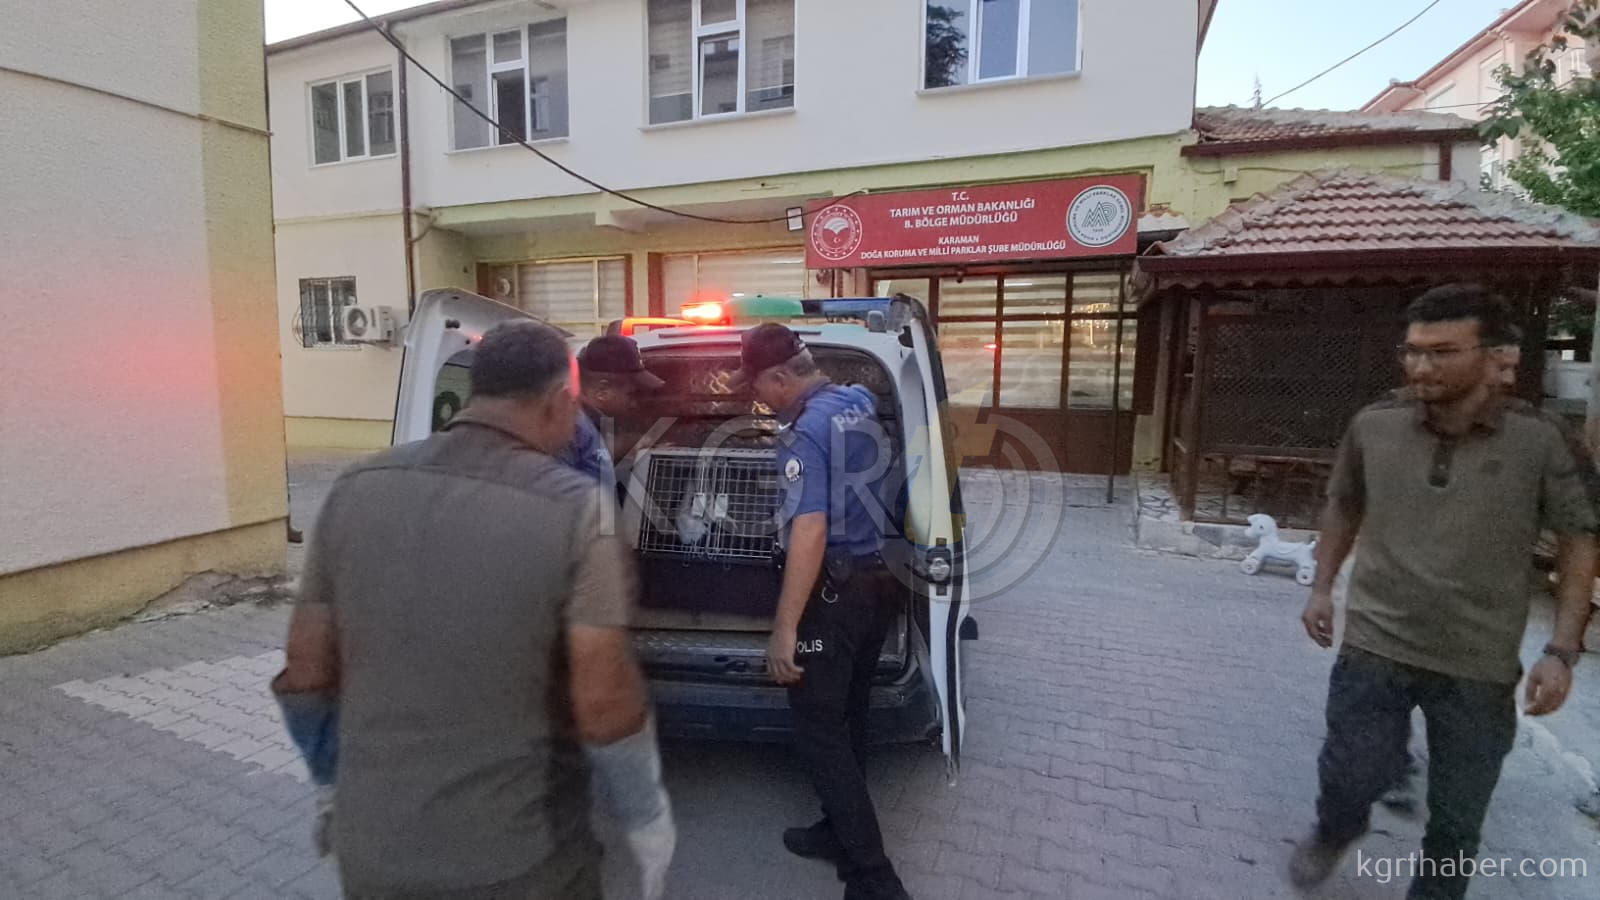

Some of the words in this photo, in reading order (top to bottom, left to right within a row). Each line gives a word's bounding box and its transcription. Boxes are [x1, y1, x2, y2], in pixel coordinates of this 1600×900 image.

[952, 192, 969, 201] T.C.
[890, 207, 920, 218] TARIM
[921, 206, 935, 216] VE
[936, 203, 976, 215] ORMAN
[977, 198, 1035, 213] BAKANLIĞI
[915, 214, 948, 229] BÖLGE
[949, 211, 1018, 226] MÜDÜRLÜĞÜ
[938, 235, 979, 245] KARAMAN
[860, 248, 883, 260] DOĞA
[883, 248, 917, 259] KORUMA
[916, 247, 929, 257] VE
[928, 245, 950, 257] MİLLİ
[950, 244, 987, 255] PARKLAR
[988, 244, 1009, 256] ŞUBE
[1010, 239, 1066, 252] MÜDÜRLÜĞÜ
[797, 639, 824, 653] OLIS
